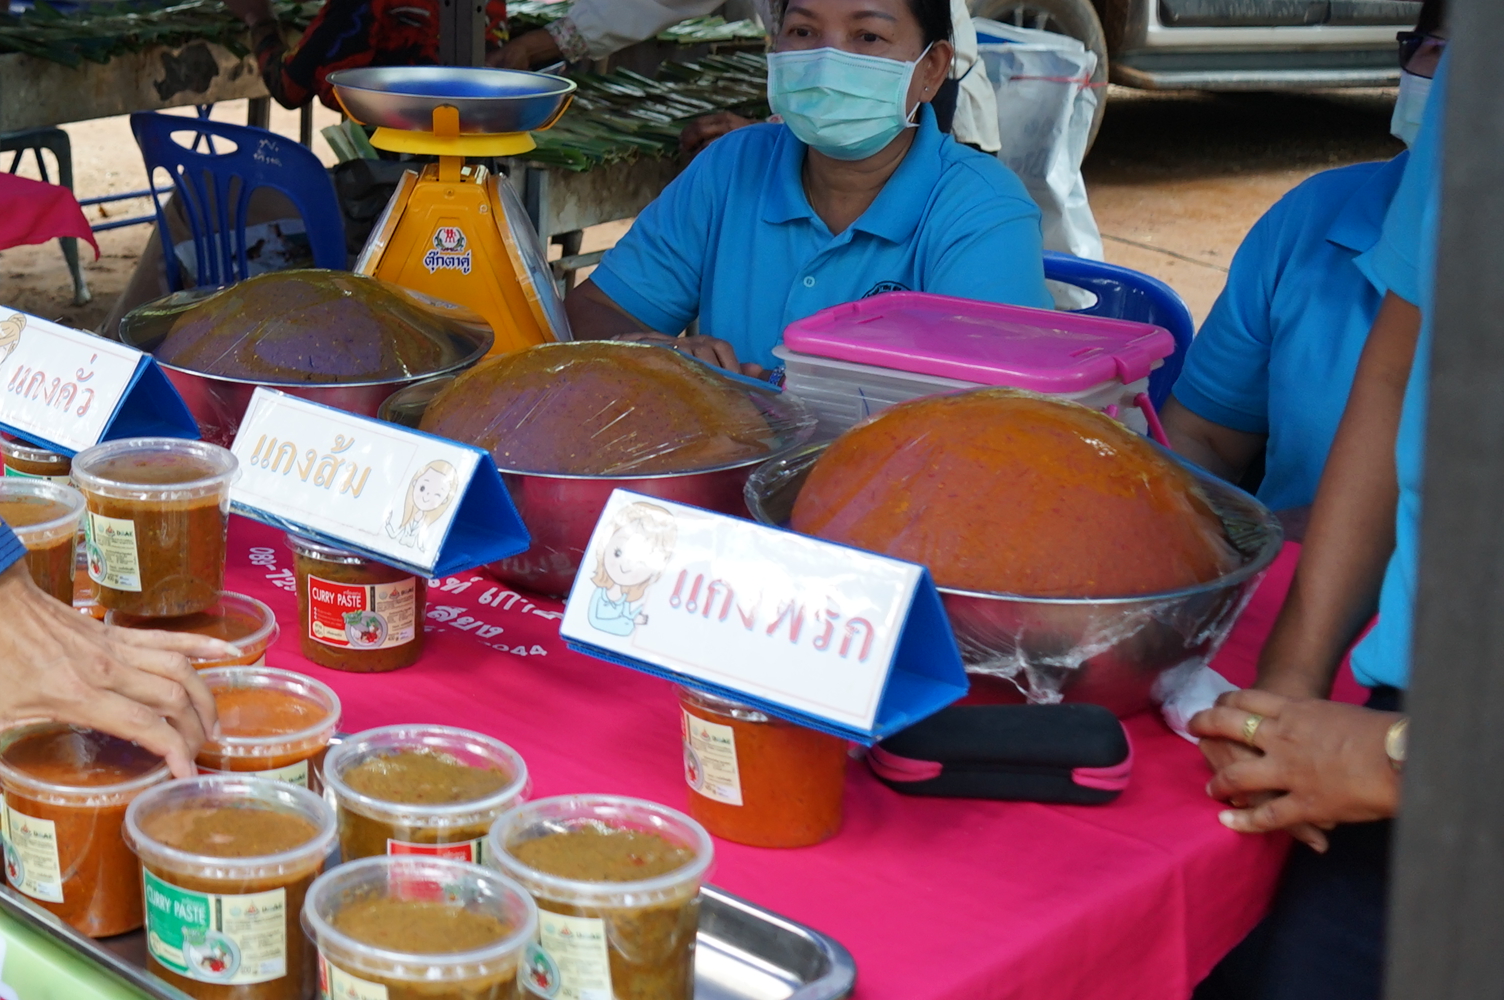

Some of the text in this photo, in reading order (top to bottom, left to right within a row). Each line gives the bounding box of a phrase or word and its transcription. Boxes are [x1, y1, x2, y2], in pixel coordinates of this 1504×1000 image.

[7, 353, 98, 418] แกงคั่ว
[250, 433, 373, 499] แกงส้ม
[311, 586, 362, 608] CURRY PASTE
[146, 883, 207, 926] CURRY PASTE
